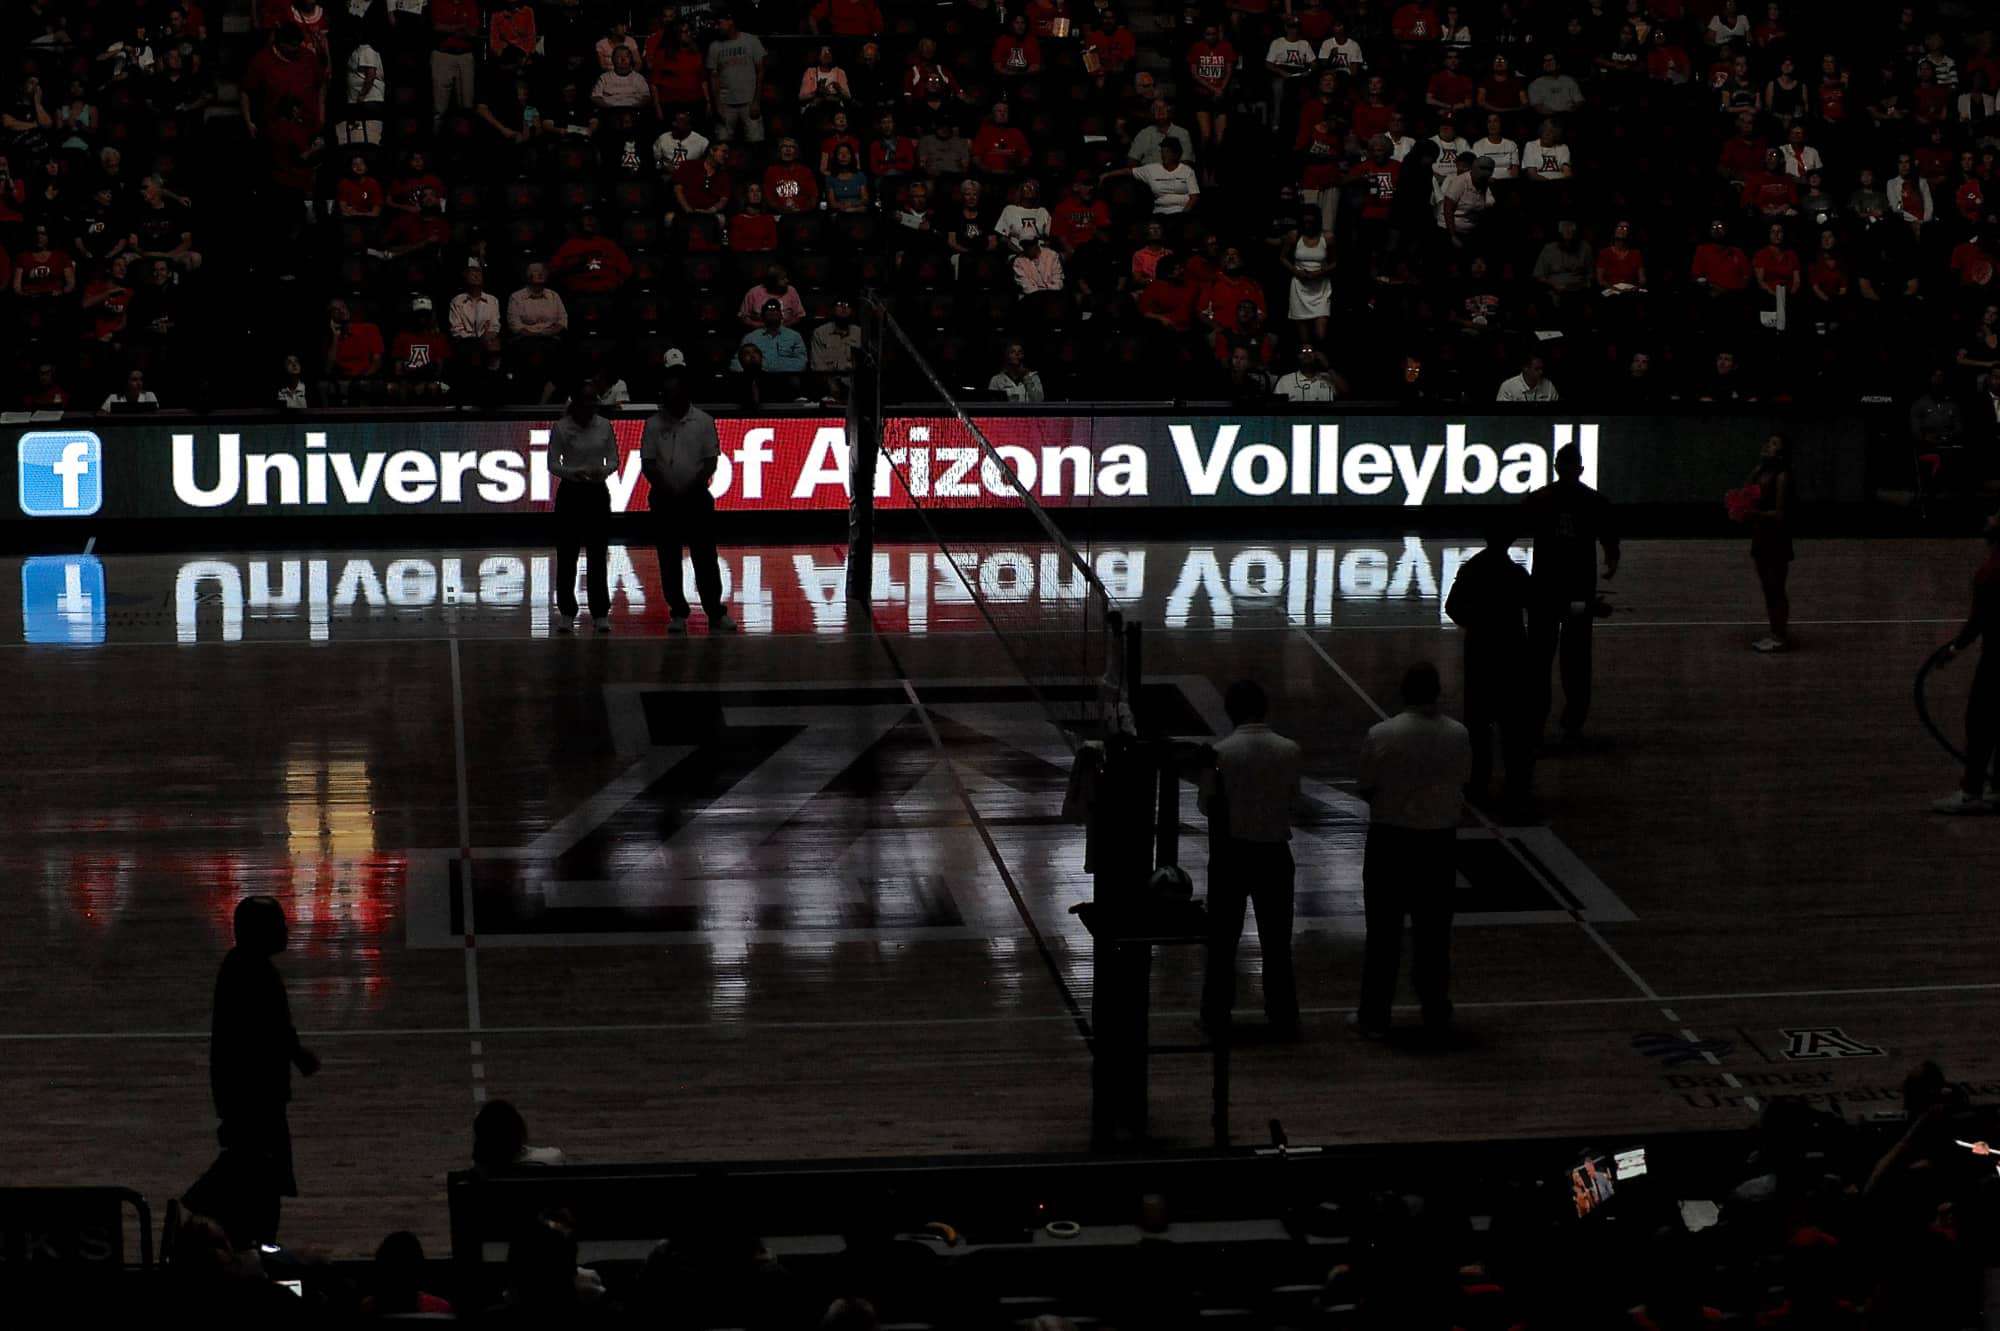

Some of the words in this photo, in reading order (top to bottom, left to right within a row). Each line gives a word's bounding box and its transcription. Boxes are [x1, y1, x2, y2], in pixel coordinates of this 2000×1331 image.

[408, 344, 431, 368] A
[172, 430, 642, 513] Universiy
[791, 426, 1148, 497] Arizona
[1778, 1025, 1888, 1060] A
[0, 1231, 112, 1263] KS
